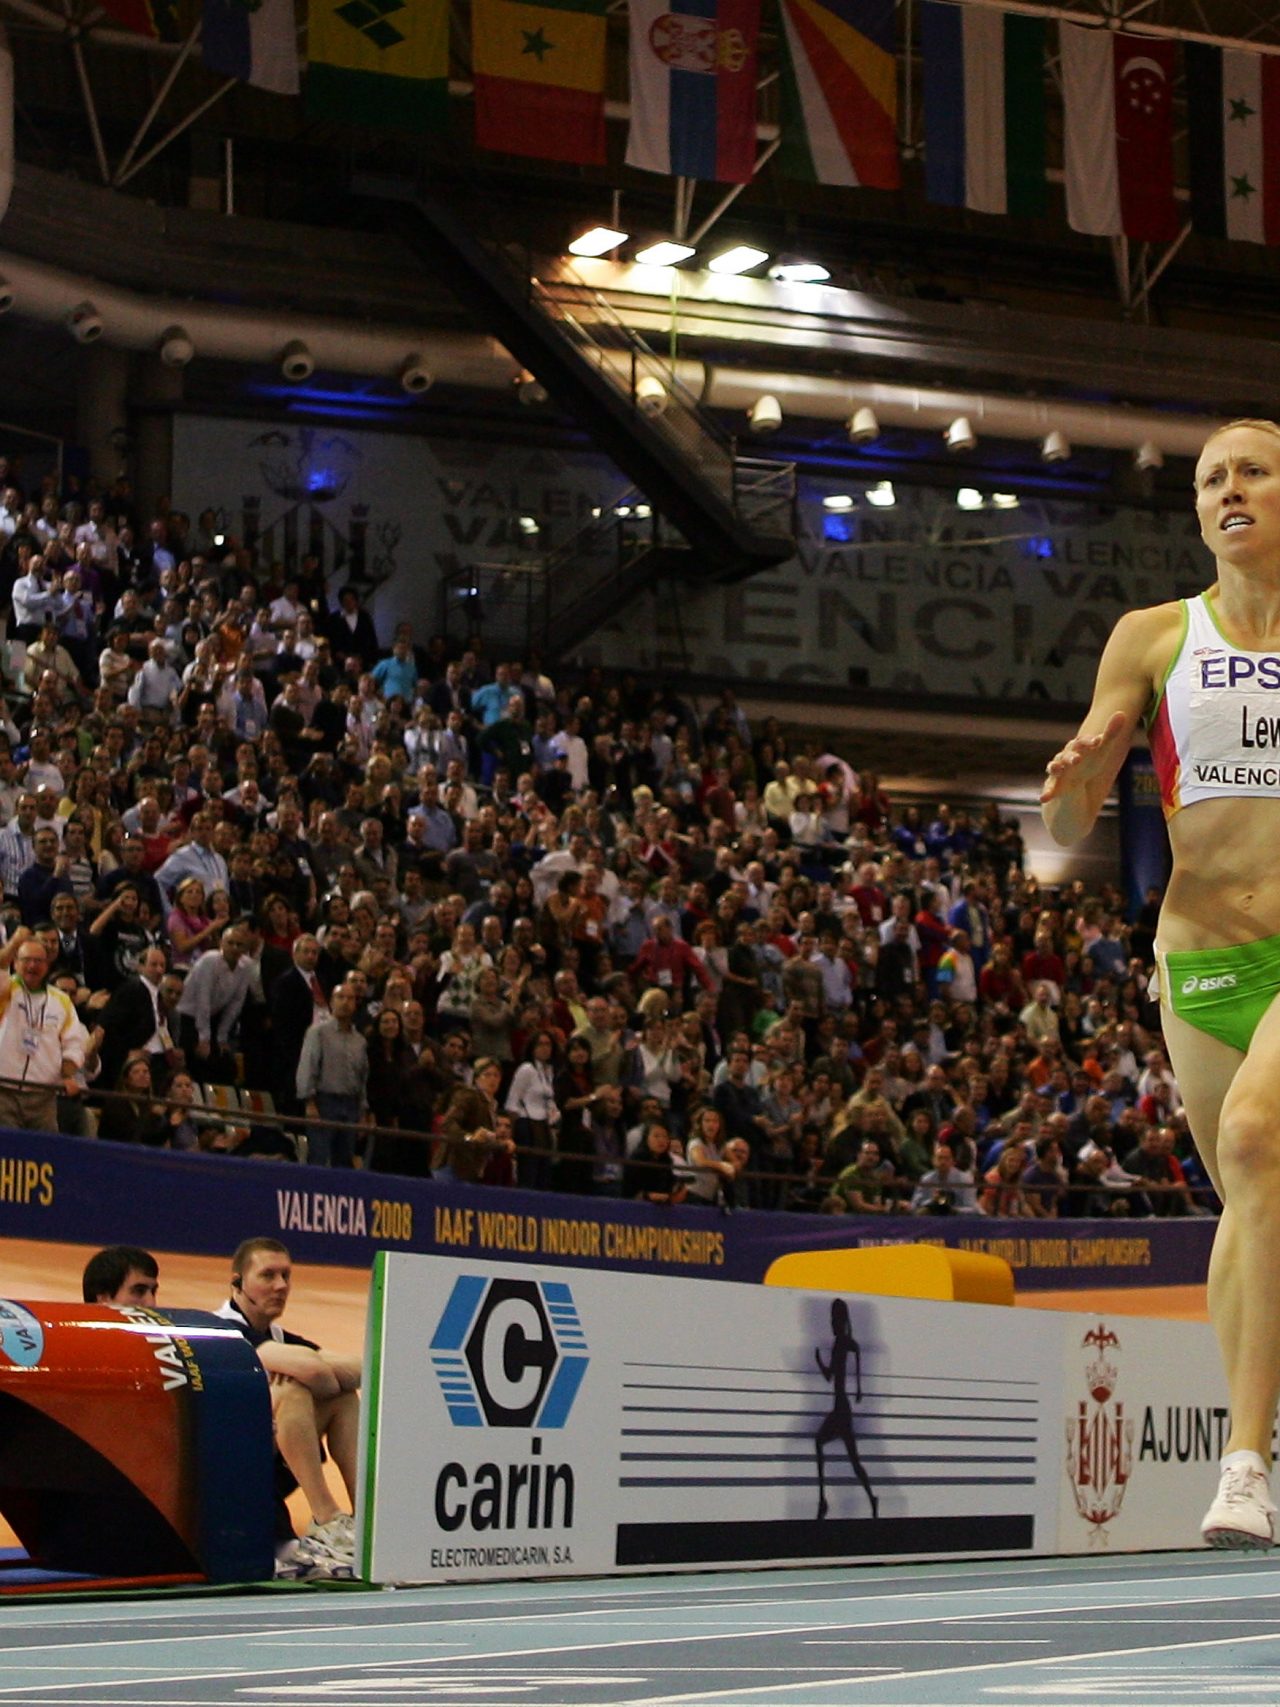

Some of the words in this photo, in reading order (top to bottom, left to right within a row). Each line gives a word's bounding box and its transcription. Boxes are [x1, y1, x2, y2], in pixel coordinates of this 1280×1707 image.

[799, 551, 1013, 592] VALENCIA
[1200, 973, 1238, 992] asics
[277, 1188, 366, 1237] VALENCIA
[371, 1200, 412, 1241] 2008
[434, 1206, 473, 1244] IAAF
[476, 1210, 538, 1253] WORLD
[541, 1217, 602, 1258] INDOOR
[603, 1223, 725, 1267] CHAMPIONSHIPS
[434, 1436, 575, 1532] carin
